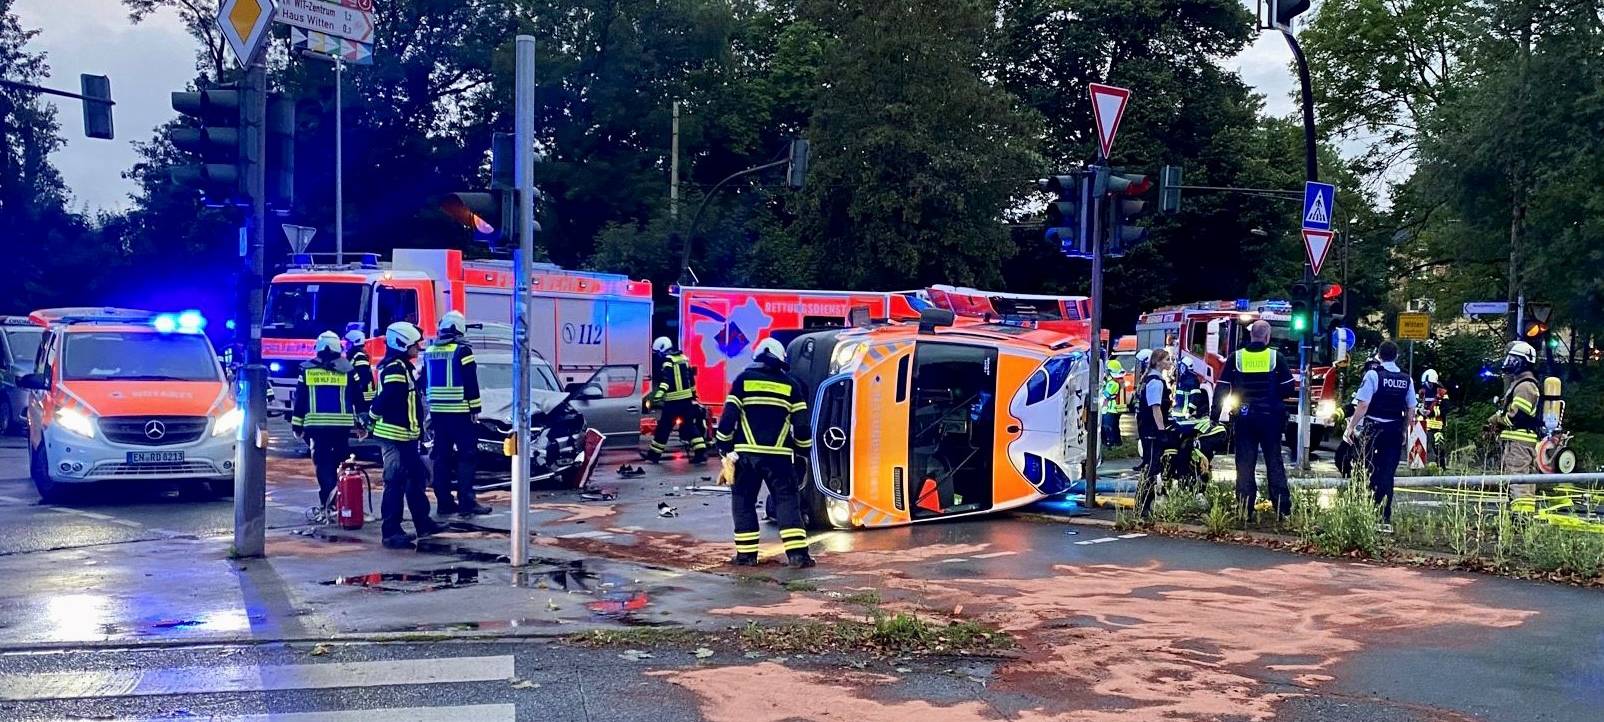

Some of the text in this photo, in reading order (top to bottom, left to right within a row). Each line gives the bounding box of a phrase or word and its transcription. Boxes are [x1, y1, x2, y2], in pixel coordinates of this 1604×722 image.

[282, 9, 304, 22] Haus
[306, 15, 334, 30] Witten
[766, 303, 847, 314] RETTUNGSDIENST
[578, 324, 602, 345] 112
[1383, 378, 1408, 389] POLIZEI
